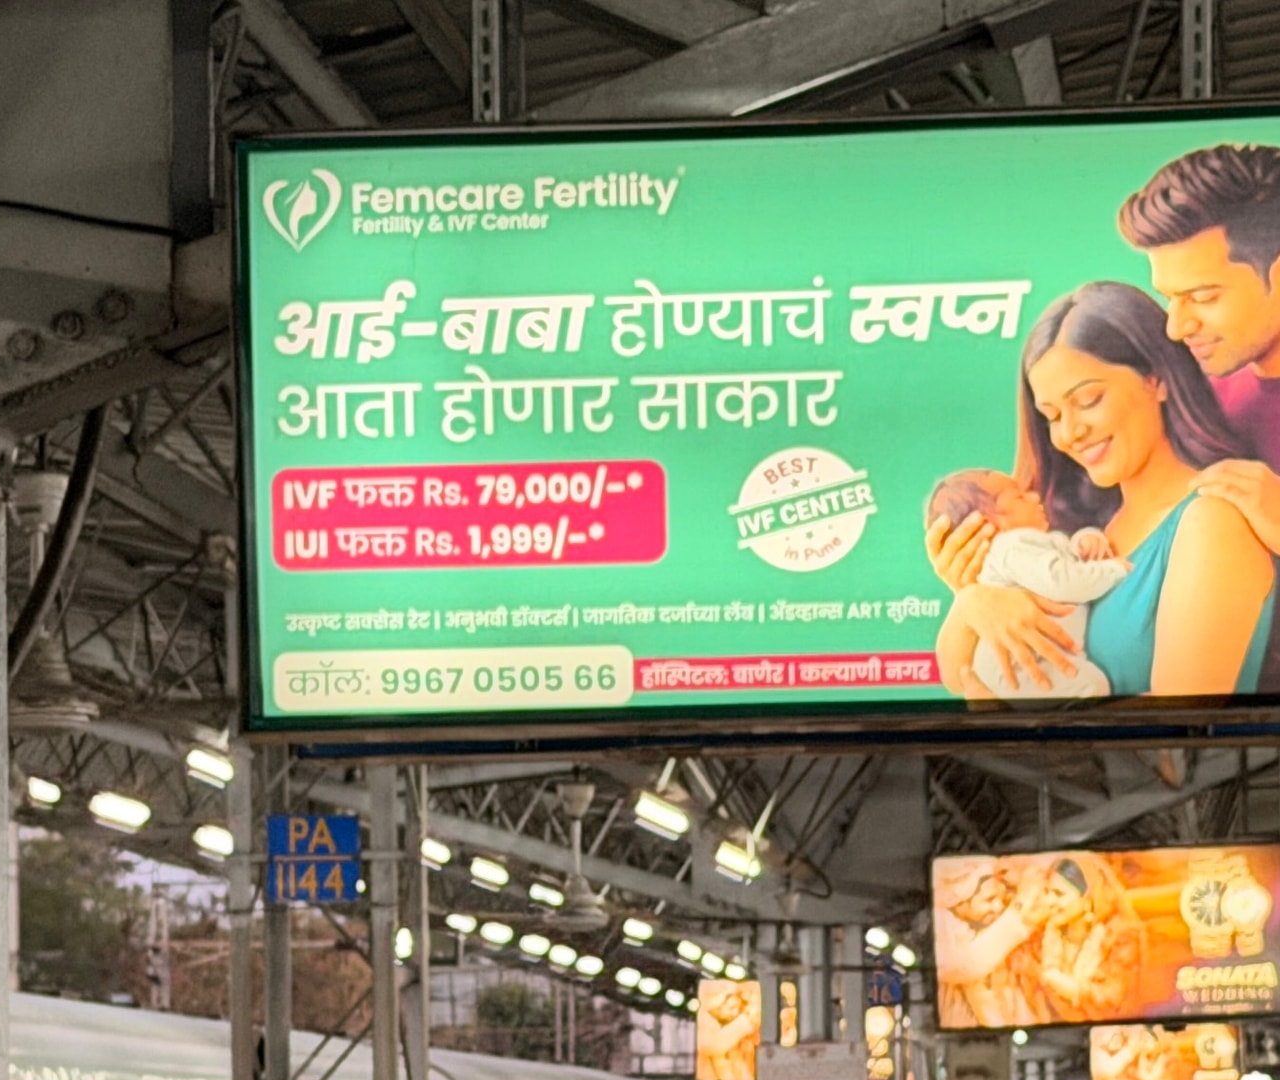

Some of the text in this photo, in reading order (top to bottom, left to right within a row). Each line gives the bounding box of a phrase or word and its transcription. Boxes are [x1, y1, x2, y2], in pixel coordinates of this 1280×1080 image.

[351, 171, 678, 215] Femcare Fertility
[352, 212, 549, 238] Fertility & IVF Center
[274, 275, 1032, 363] आई-बाबा होण्याचं स्वप्न
[277, 364, 843, 443] आता होणार साकार
[763, 457, 819, 485] BEST
[282, 480, 337, 509] IVF
[342, 476, 416, 508] फक्त
[423, 478, 469, 507] Rs.
[737, 483, 874, 537] IVF CENTER
[284, 529, 329, 559] IUI
[335, 526, 409, 558] फक्त
[415, 527, 461, 556] Rs.
[804, 537, 842, 560] Pune
[345, 608, 404, 630] सक्सेस
[407, 607, 430, 630] रेट
[445, 605, 507, 633] अनुभवी
[511, 604, 571, 627] डॉक्टर्स
[582, 601, 656, 625] जागतिक
[658, 601, 720, 624] दर्जाच्या
[846, 601, 882, 620] ART
[886, 595, 941, 623] सुविधा
[285, 659, 616, 696] कॉल: 9967 0505 66
[798, 655, 881, 682] कल्याणी
[885, 659, 932, 681] नगर
[289, 817, 337, 854] PA
[276, 863, 344, 901] 1144
[1176, 962, 1278, 990] SONATA
